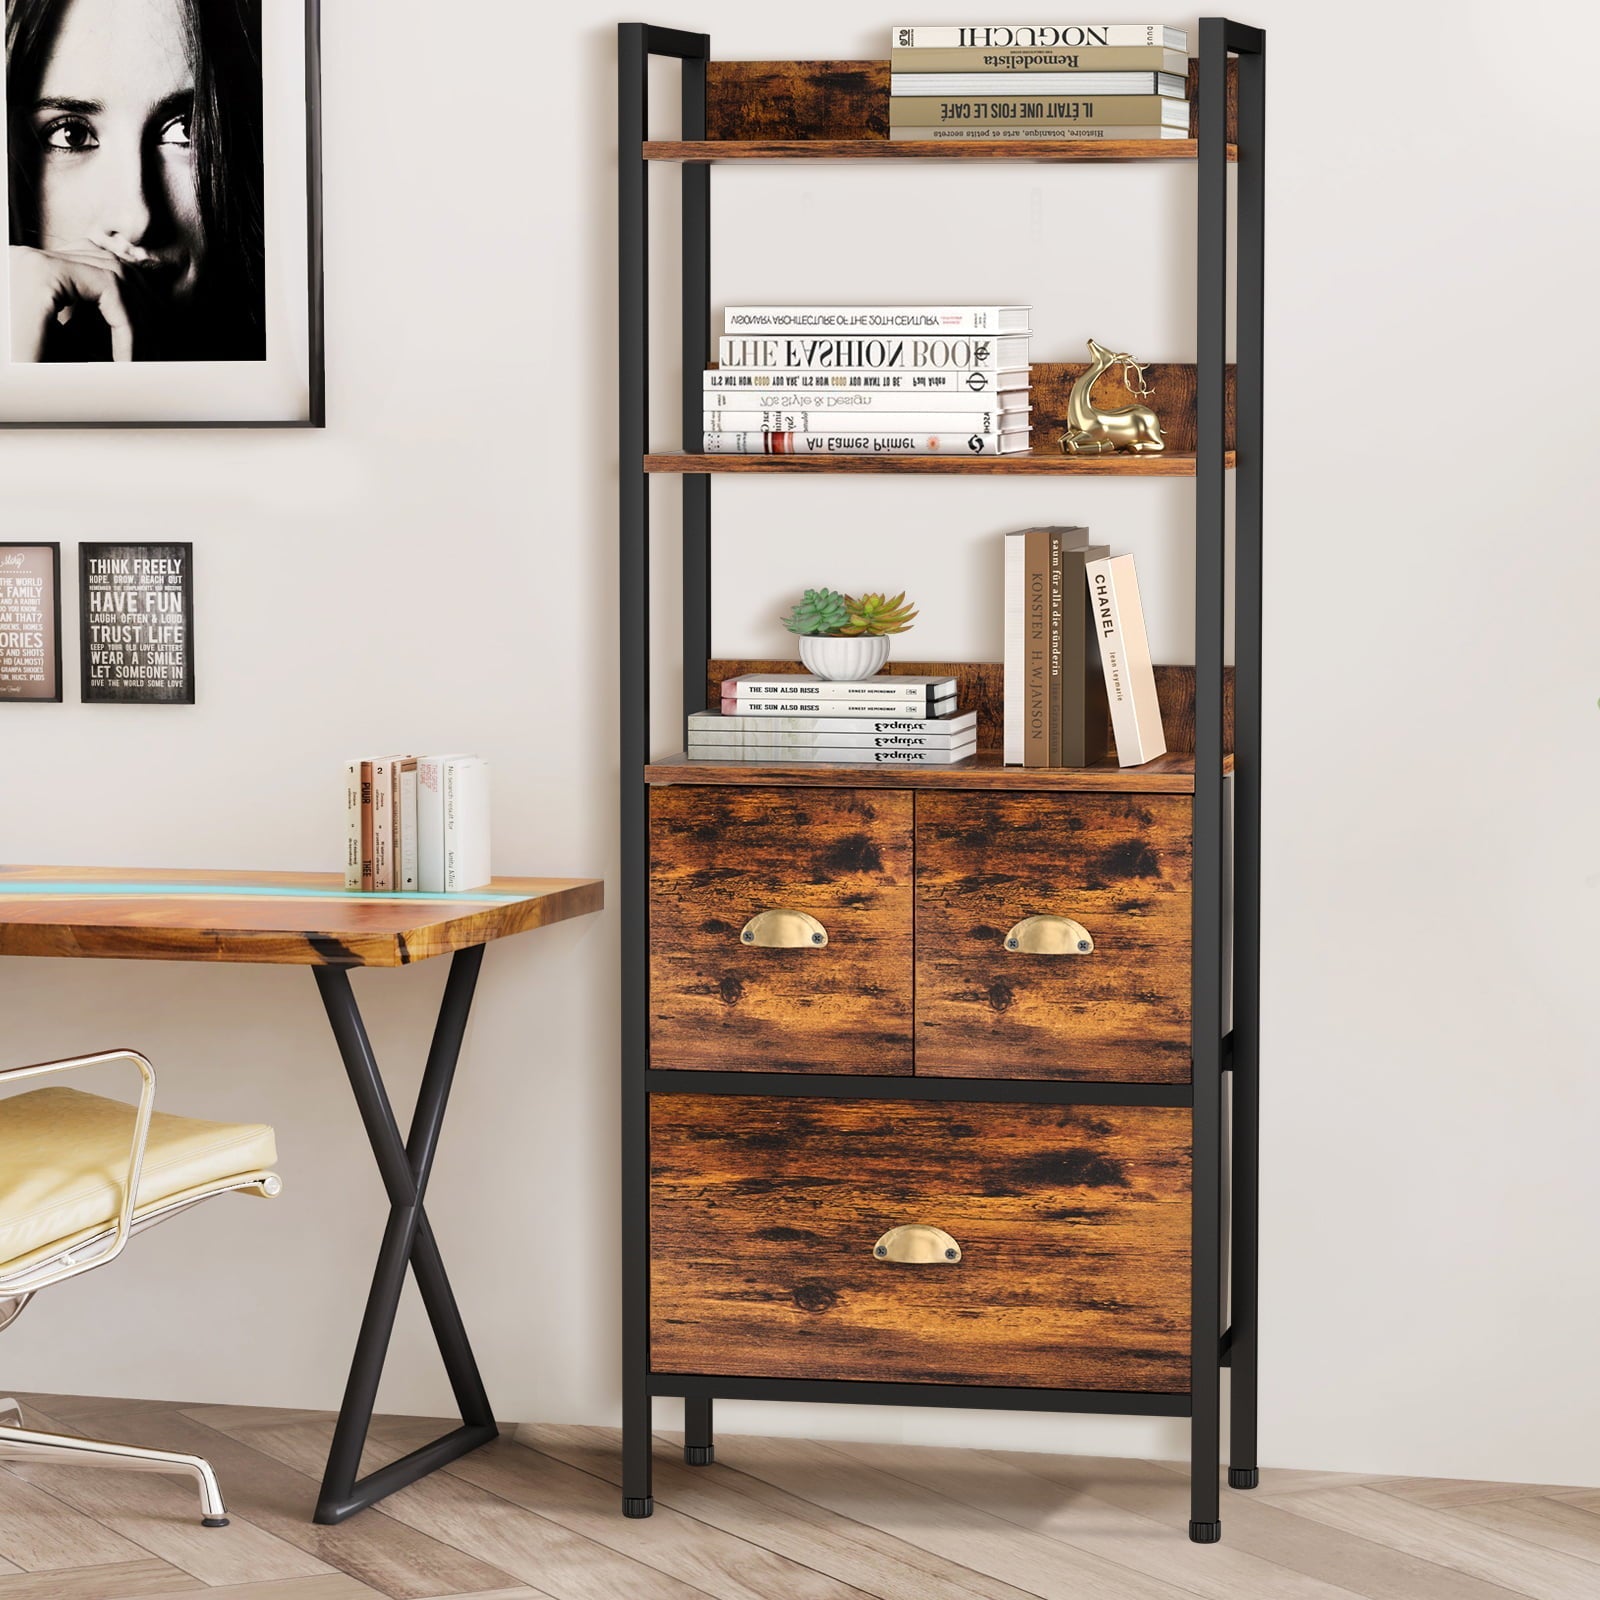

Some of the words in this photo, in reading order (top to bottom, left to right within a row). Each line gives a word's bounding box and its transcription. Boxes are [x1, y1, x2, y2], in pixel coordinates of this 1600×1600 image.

[958, 26, 1110, 47] NOGUCHI
[983, 55, 1079, 68] Remodelista
[941, 102, 971, 122] CAFÉ
[974, 102, 988, 118] LE
[991, 102, 1017, 118] FOIS
[1020, 102, 1043, 118] UNE
[1046, 102, 1079, 122] ÉTAIT
[1083, 102, 1093, 118] IL
[933, 130, 963, 138] secrets
[966, 130, 990, 138] petits
[992, 130, 1000, 138] et
[1002, 130, 1020, 138] arts
[90, 559, 129, 574] THINK
[134, 559, 182, 574] FREELY
[16, 578, 42, 586] WORLD
[140, 575, 164, 584] REACH
[168, 575, 182, 584] OUT
[7, 586, 42, 598] FAMILY
[1052, 587, 1061, 608] alla
[90, 591, 138, 612] HAVE
[146, 591, 182, 612] FUN
[1032, 573, 1043, 640] KONSTEN
[1095, 574, 1114, 638] CHANEL
[15, 612, 43, 622] THAT?
[90, 613, 117, 624] LAUGH
[122, 613, 147, 624] OFTEN
[161, 613, 183, 624] LOUD
[1052, 610, 1061, 627] die
[91, 625, 142, 643] TRUST
[149, 625, 183, 643] LIFE
[91, 652, 124, 665] WEAR
[132, 652, 139, 665] A
[147, 652, 183, 665] SMILE
[1052, 629, 1061, 676] sünderin
[91, 666, 111, 678] LET
[115, 666, 168, 678] SOMEONE
[172, 666, 183, 678] IN
[123, 679, 144, 687] WORLD
[147, 679, 164, 687] SOME
[167, 679, 183, 687] LOVE
[361, 782, 371, 804] PUUR
[362, 860, 372, 878] THEE
